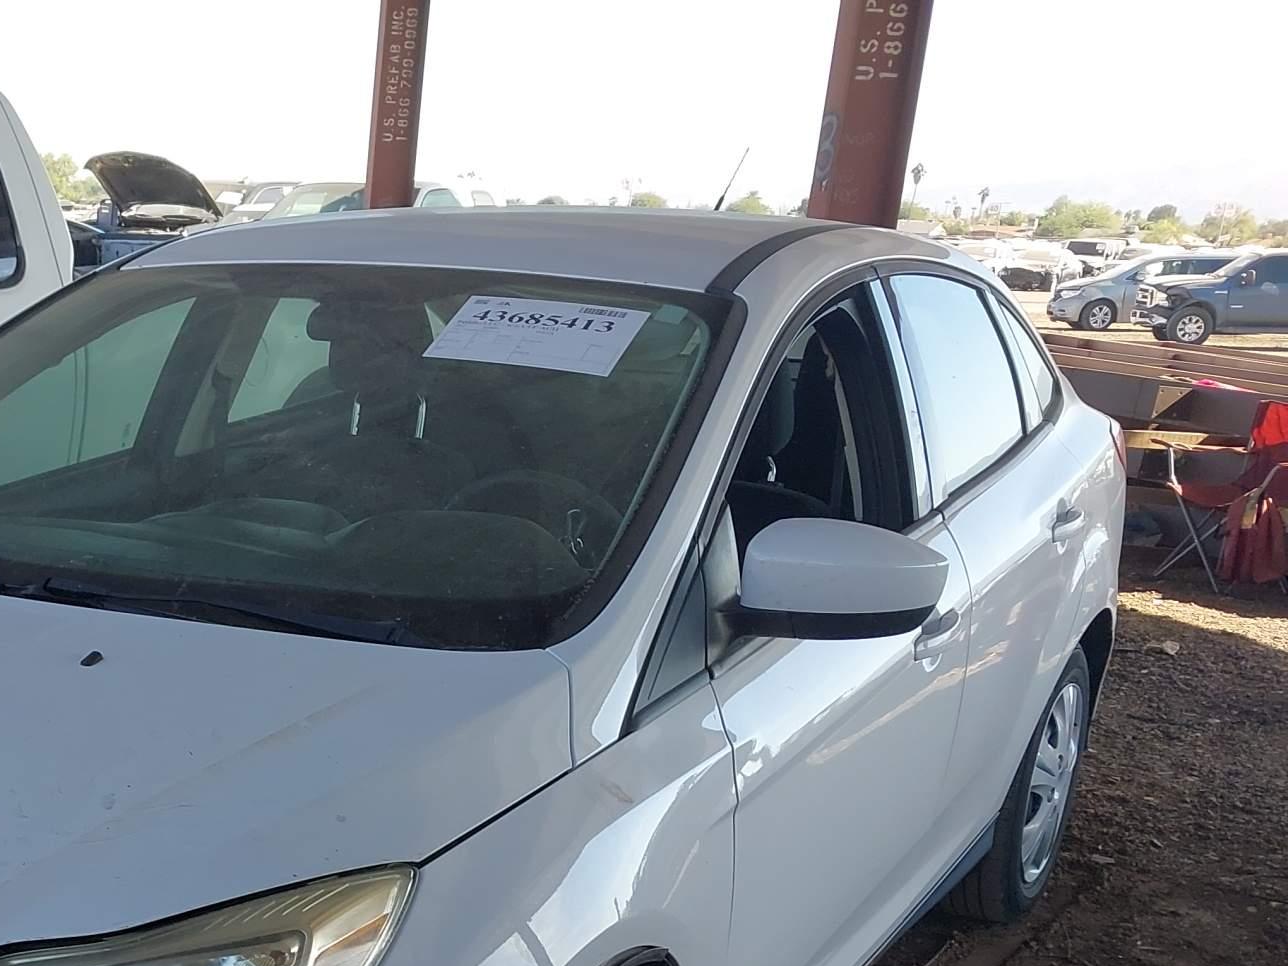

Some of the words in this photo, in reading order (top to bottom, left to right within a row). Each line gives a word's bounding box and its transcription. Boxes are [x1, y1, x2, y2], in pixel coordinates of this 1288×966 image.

[392, 5, 406, 36] INC.
[879, 3, 909, 78] 1-866
[385, 43, 402, 104] PREFAB
[854, 31, 882, 80] U.S.
[383, 112, 397, 142] U.S.
[395, 98, 411, 141] 1-866
[472, 309, 616, 333] 43685413
